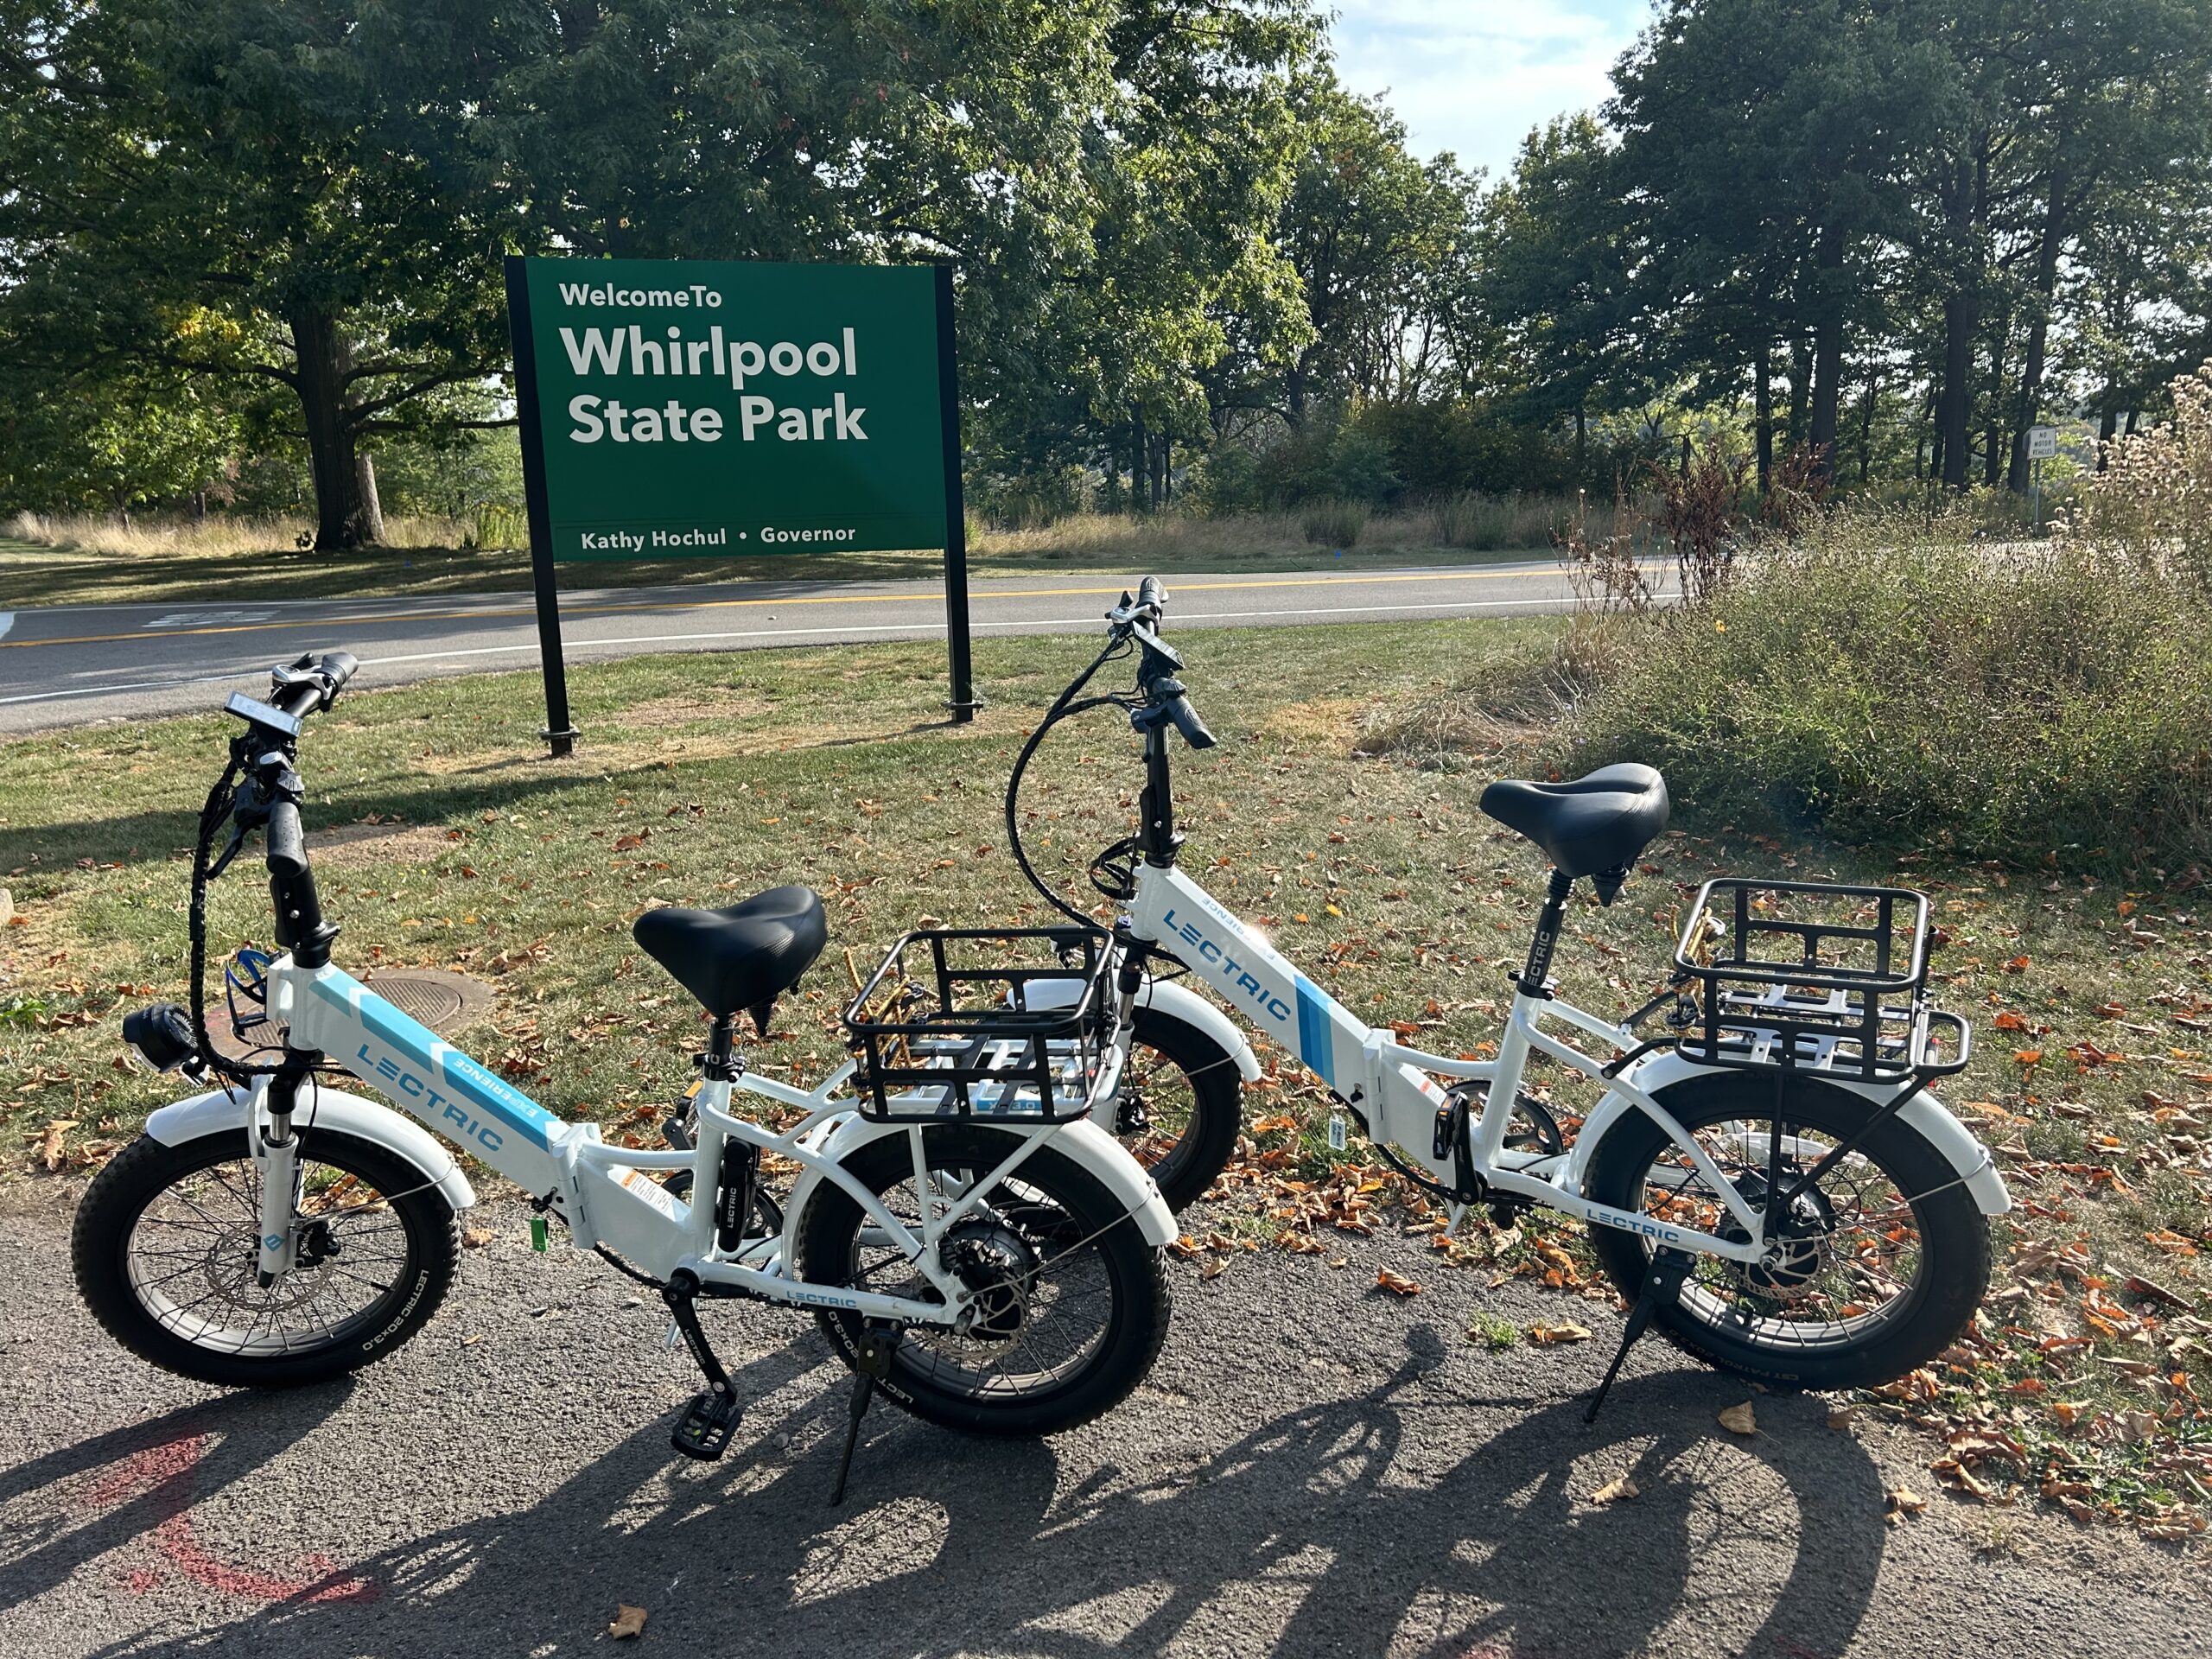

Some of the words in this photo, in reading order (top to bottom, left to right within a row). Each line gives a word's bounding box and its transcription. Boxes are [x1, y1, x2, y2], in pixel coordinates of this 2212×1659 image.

[558, 325, 857, 391] Whirlpool
[569, 394, 723, 443] State
[740, 392, 869, 442] Park
[581, 531, 645, 552] Kathy
[652, 527, 726, 547] Hochul
[760, 526, 855, 543] Governor
[1163, 909, 1292, 1021] LECTRIC
[1527, 931, 1550, 985] ECTRIC
[357, 1043, 504, 1153] LECTRIC
[454, 1058, 538, 1118] EXPERIENCE
[1012, 1101, 1036, 1110] 3.0
[727, 1187, 737, 1229] LECTRIC
[1587, 1209, 1679, 1243] LECTRIC
[400, 1269, 429, 1317] LECTRIC
[786, 1290, 857, 1308] LECTRIC
[684, 1329, 706, 1365] LECTRIC
